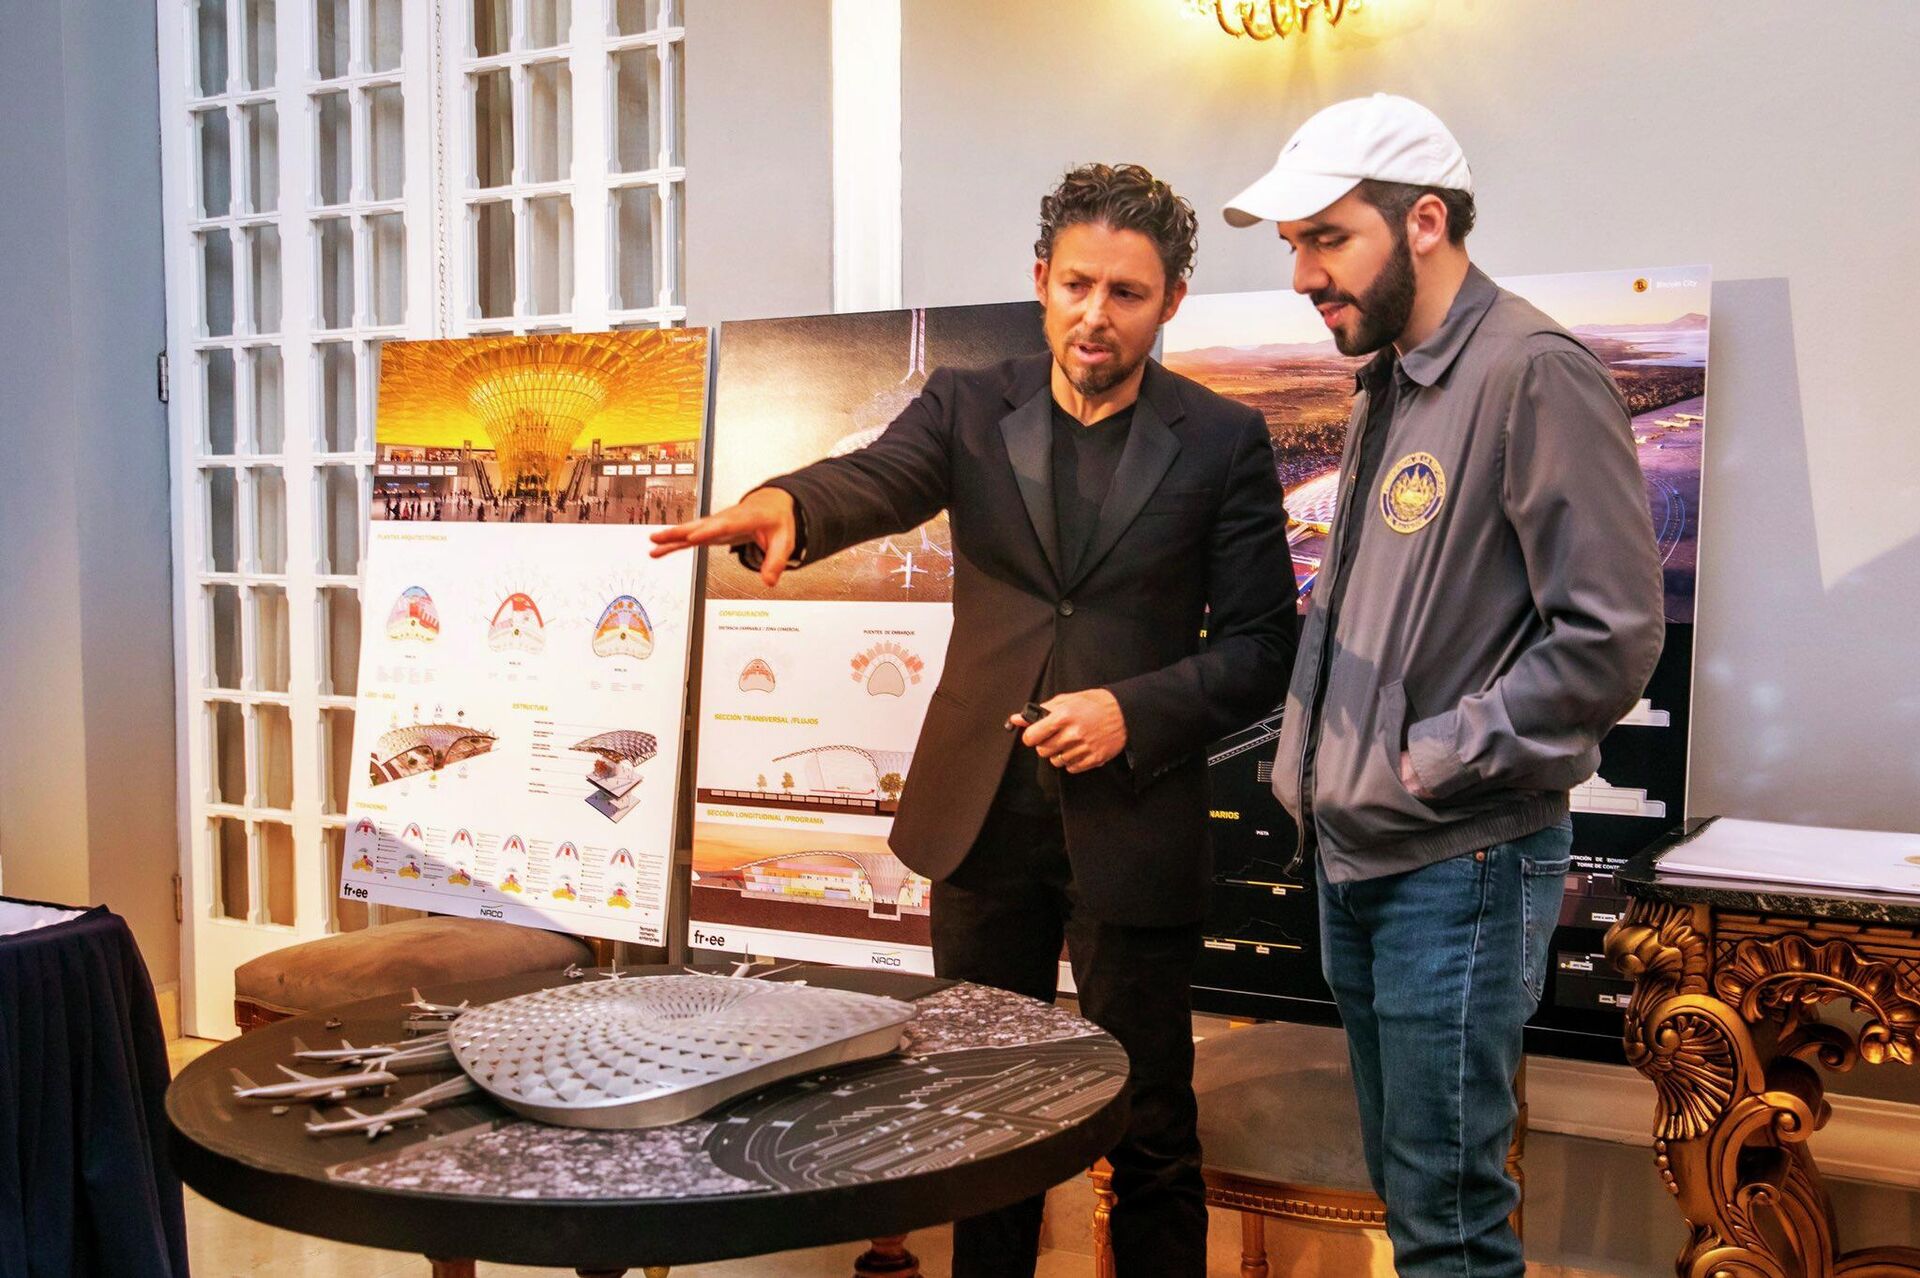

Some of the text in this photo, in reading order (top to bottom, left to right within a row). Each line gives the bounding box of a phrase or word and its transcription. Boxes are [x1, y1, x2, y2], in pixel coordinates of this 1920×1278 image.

[714, 713, 741, 721] SECCIÓN
[743, 714, 788, 724] TRANSVERSAL
[707, 809, 735, 818] SECCIÓN
[735, 811, 782, 822] LONGITUDINAL
[872, 956, 901, 967] NACO
